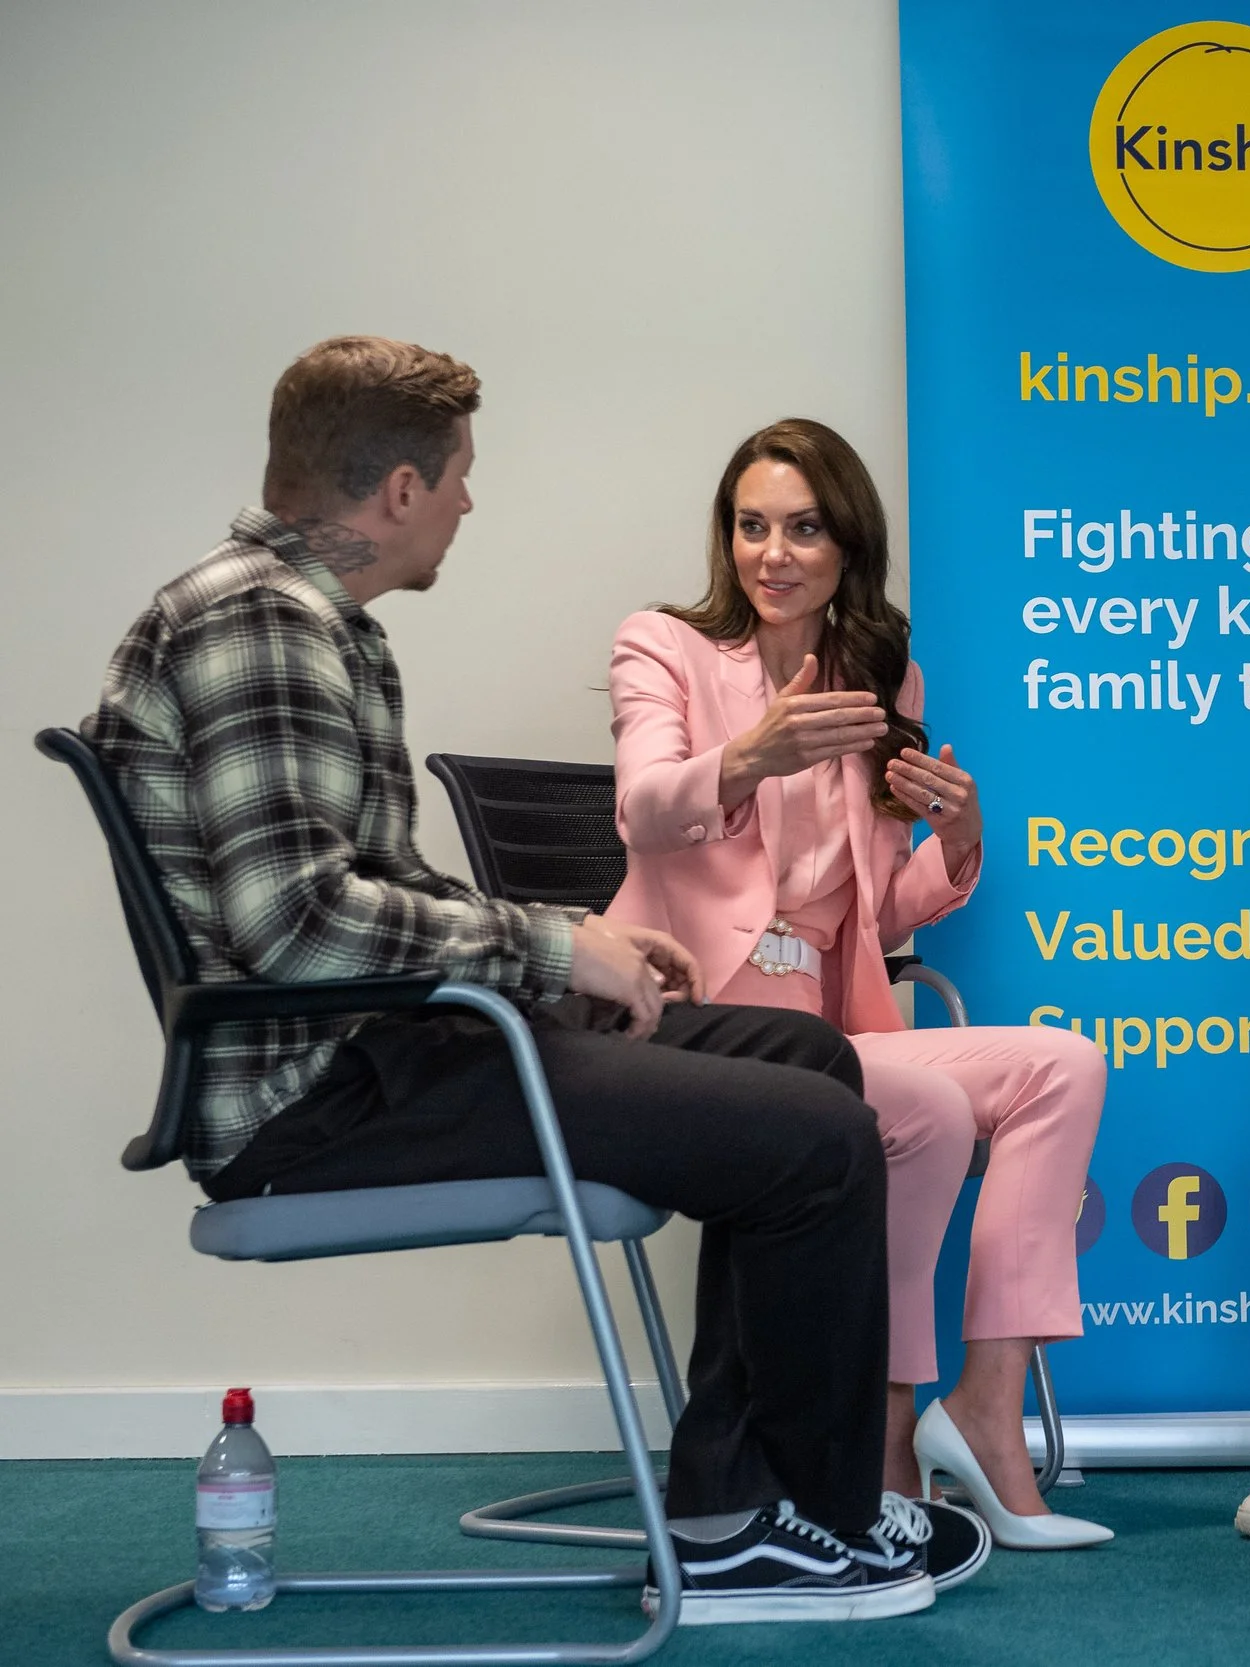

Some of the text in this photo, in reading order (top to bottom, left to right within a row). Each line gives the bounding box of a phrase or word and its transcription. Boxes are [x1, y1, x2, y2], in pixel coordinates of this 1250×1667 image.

[1022, 596, 1199, 649] every
[1022, 659, 1222, 725] family
[1157, 1175, 1201, 1260] f
